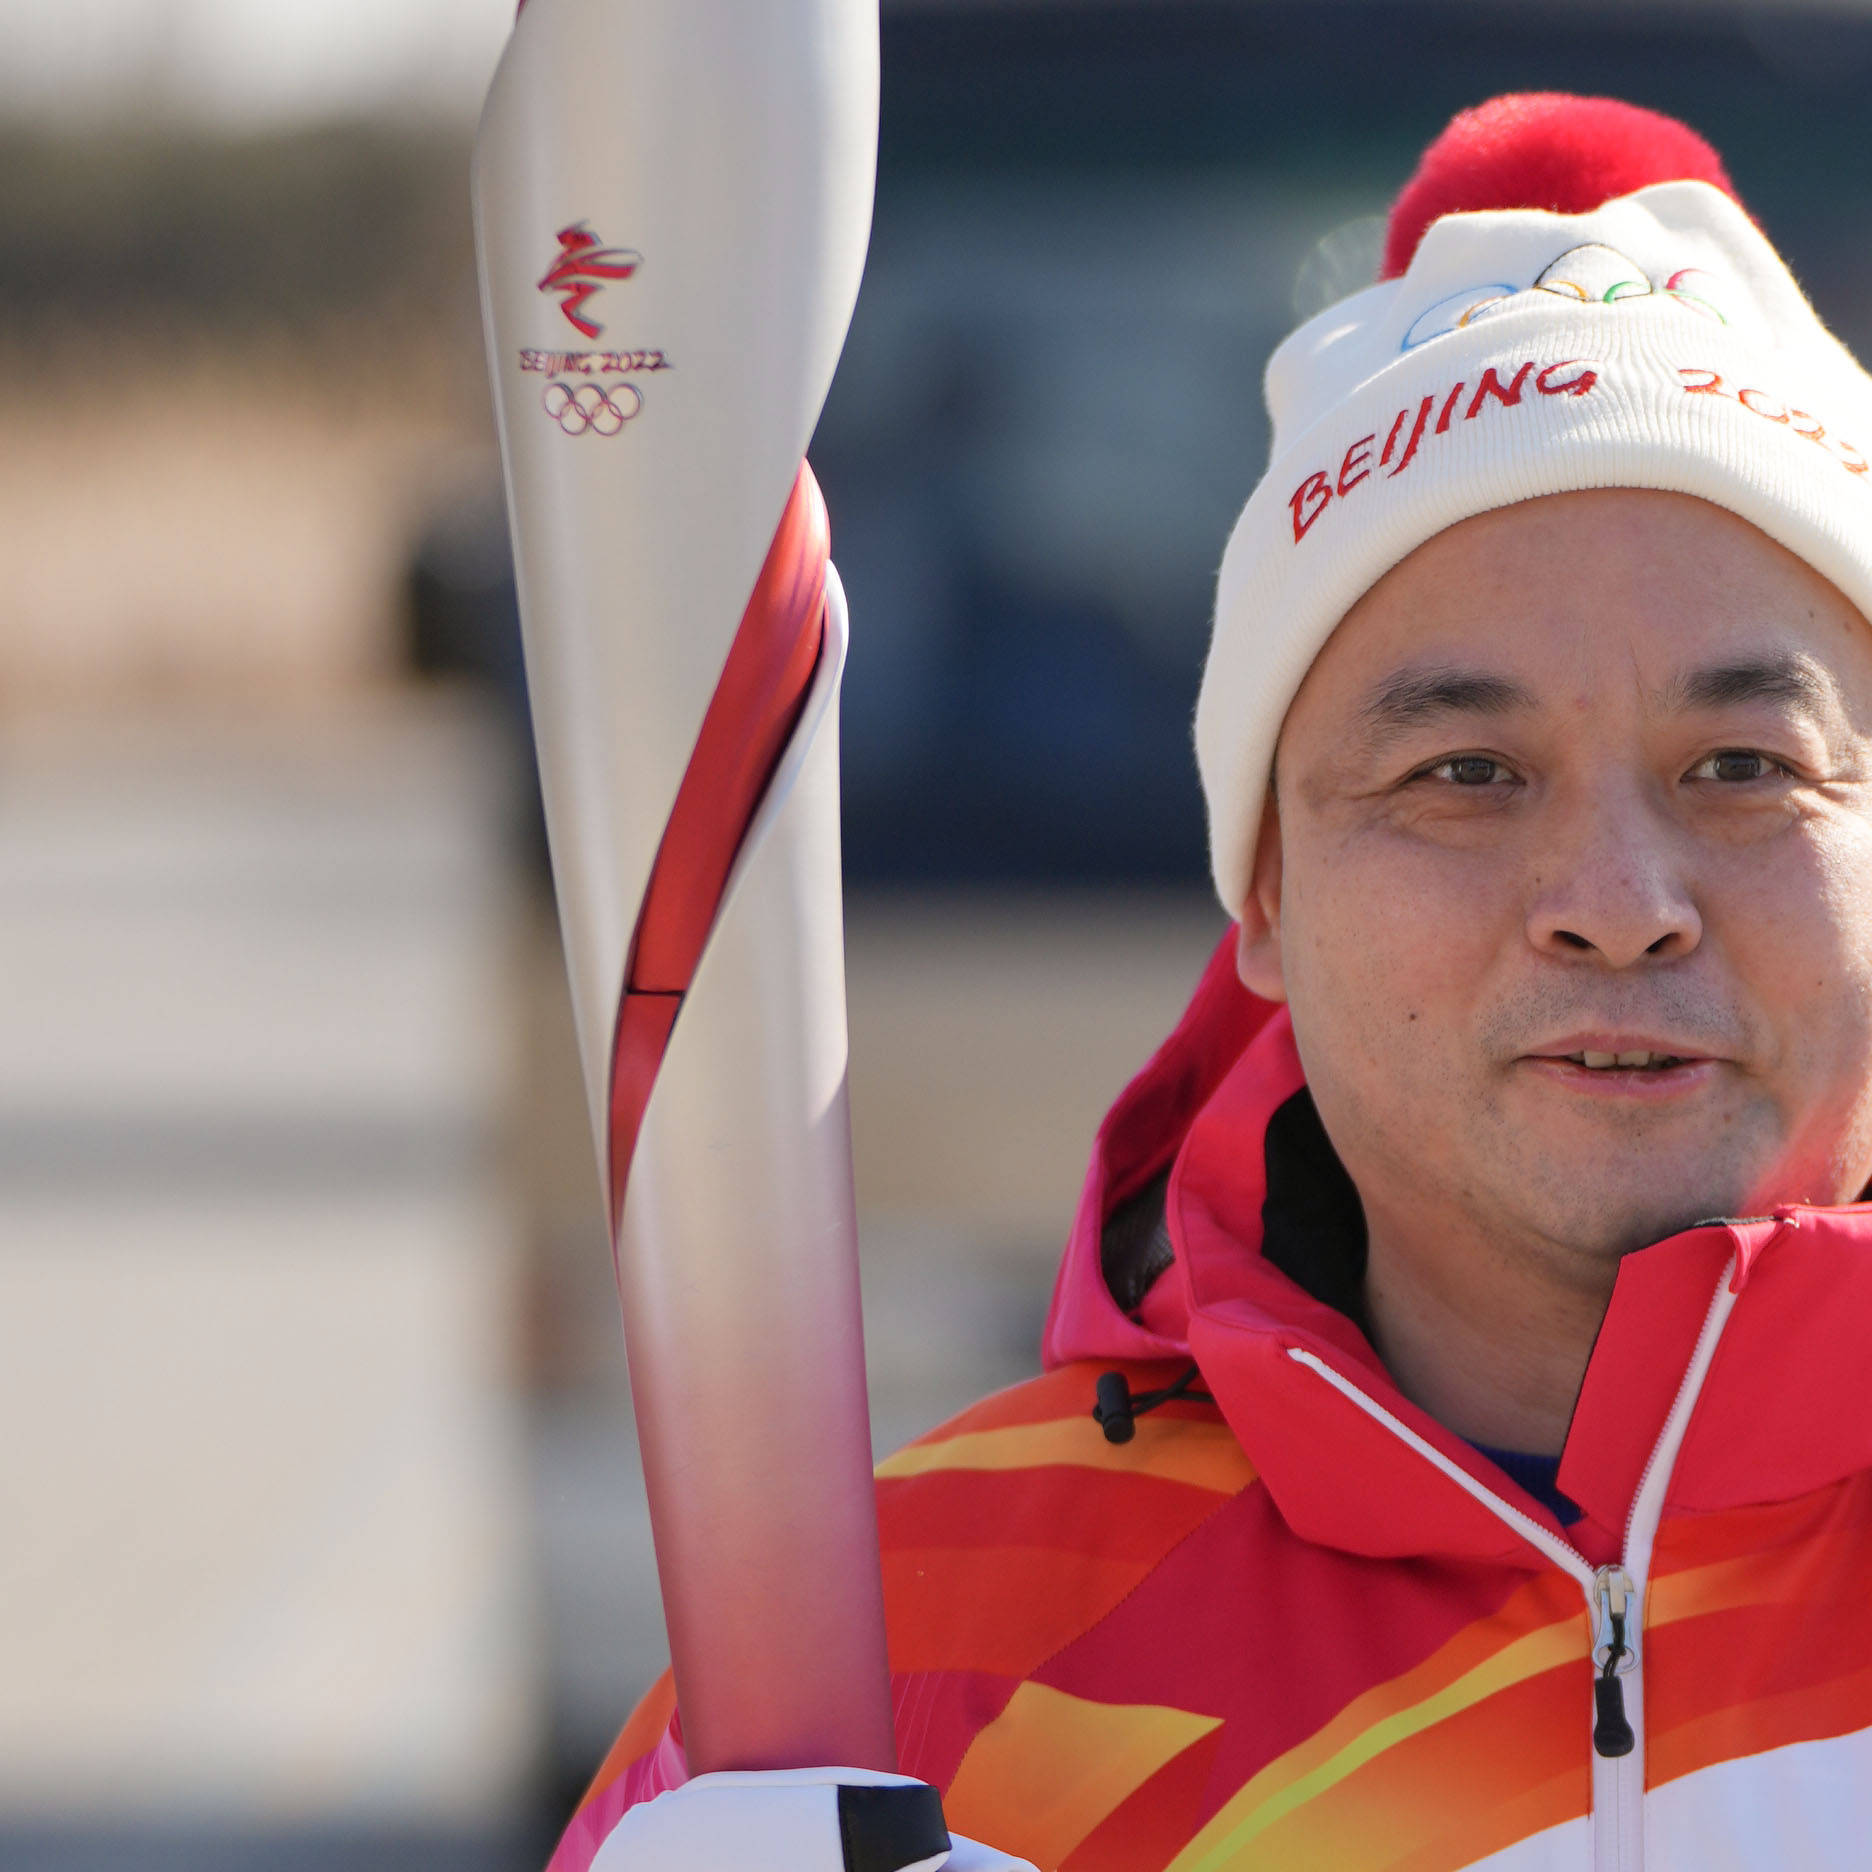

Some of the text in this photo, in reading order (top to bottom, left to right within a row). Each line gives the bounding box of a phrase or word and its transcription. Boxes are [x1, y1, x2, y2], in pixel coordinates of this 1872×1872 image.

[601, 349, 674, 373] 2022
[1288, 359, 1871, 544] BEIJING 2022
